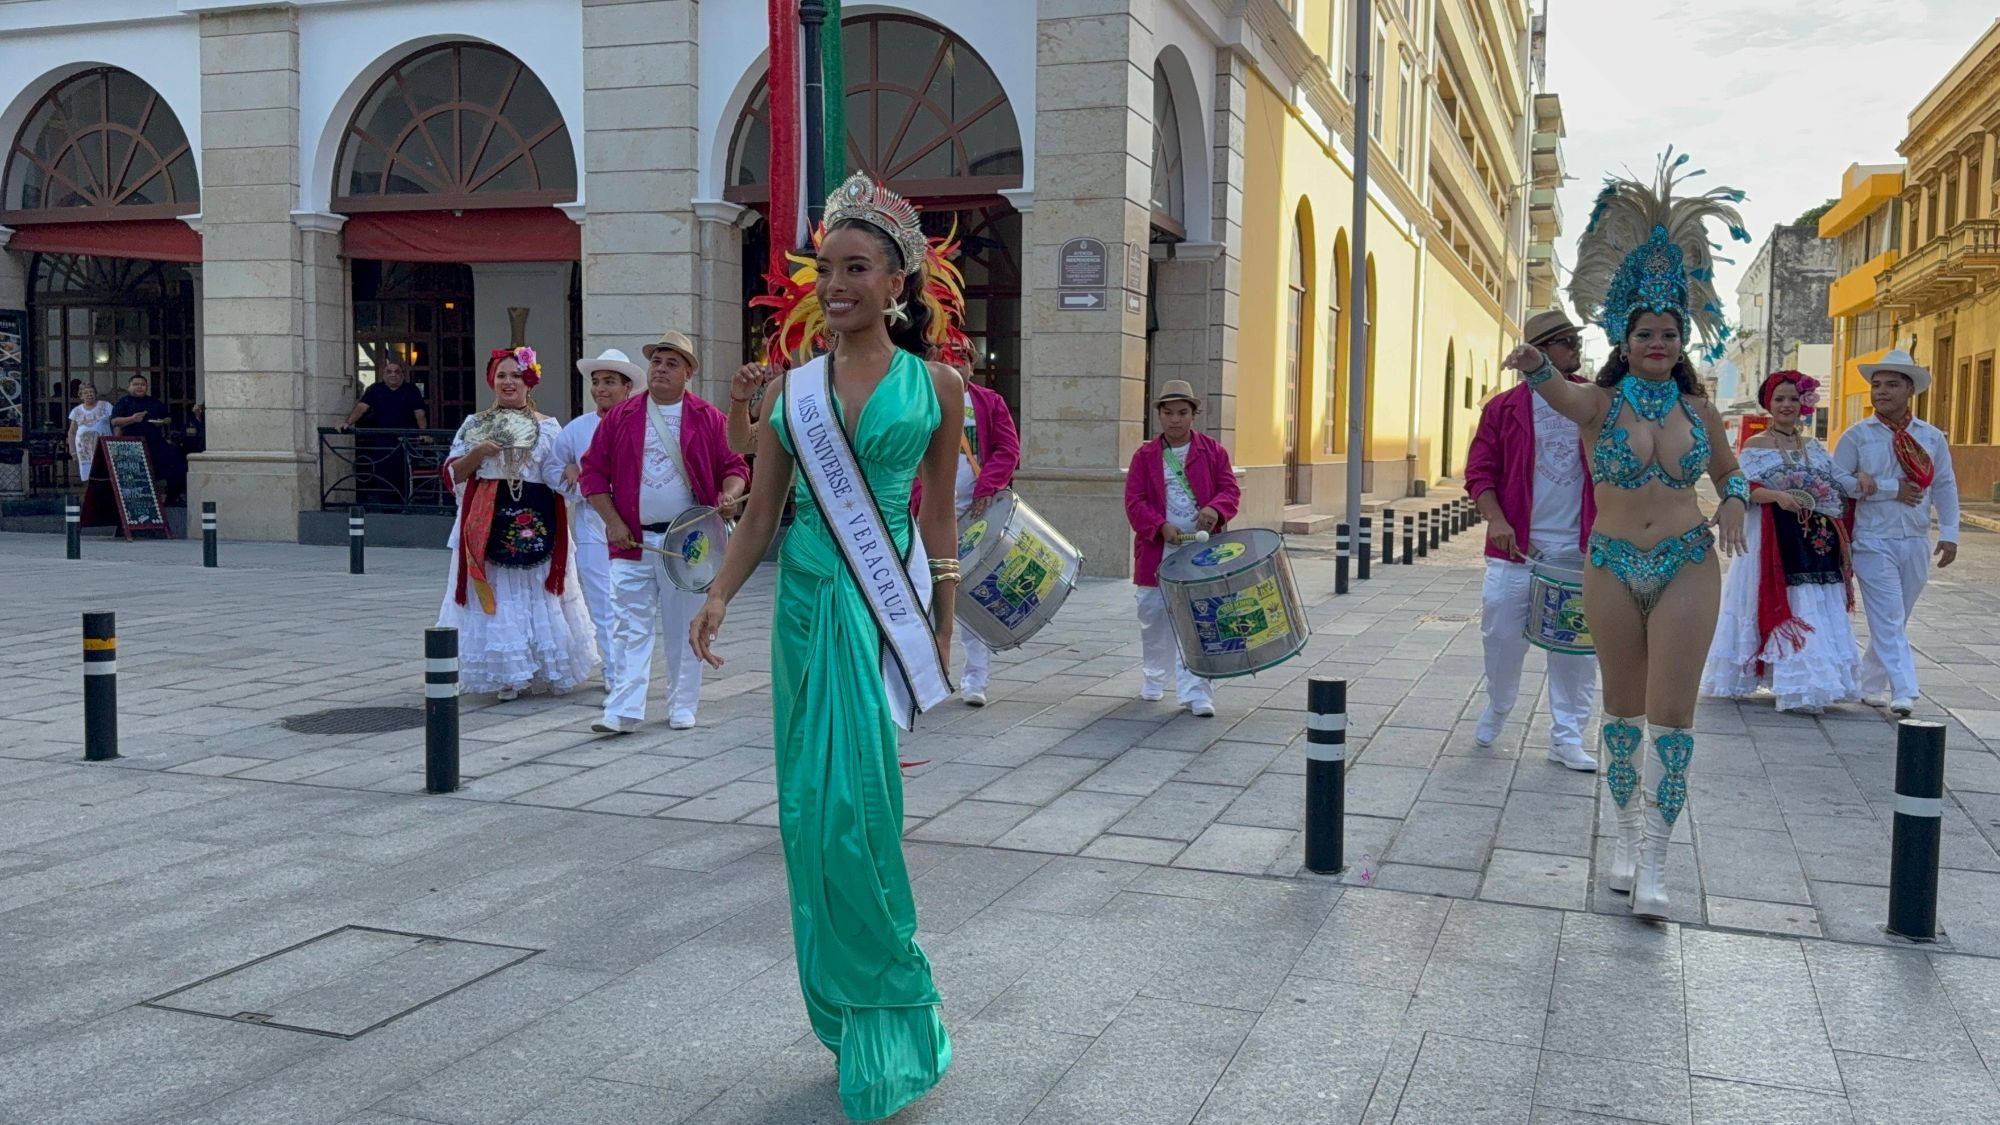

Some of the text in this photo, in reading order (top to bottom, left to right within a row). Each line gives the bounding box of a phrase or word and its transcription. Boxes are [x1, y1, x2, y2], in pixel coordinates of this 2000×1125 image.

[797, 393, 907, 621] MISS UNIVERSE VERACRUZ
